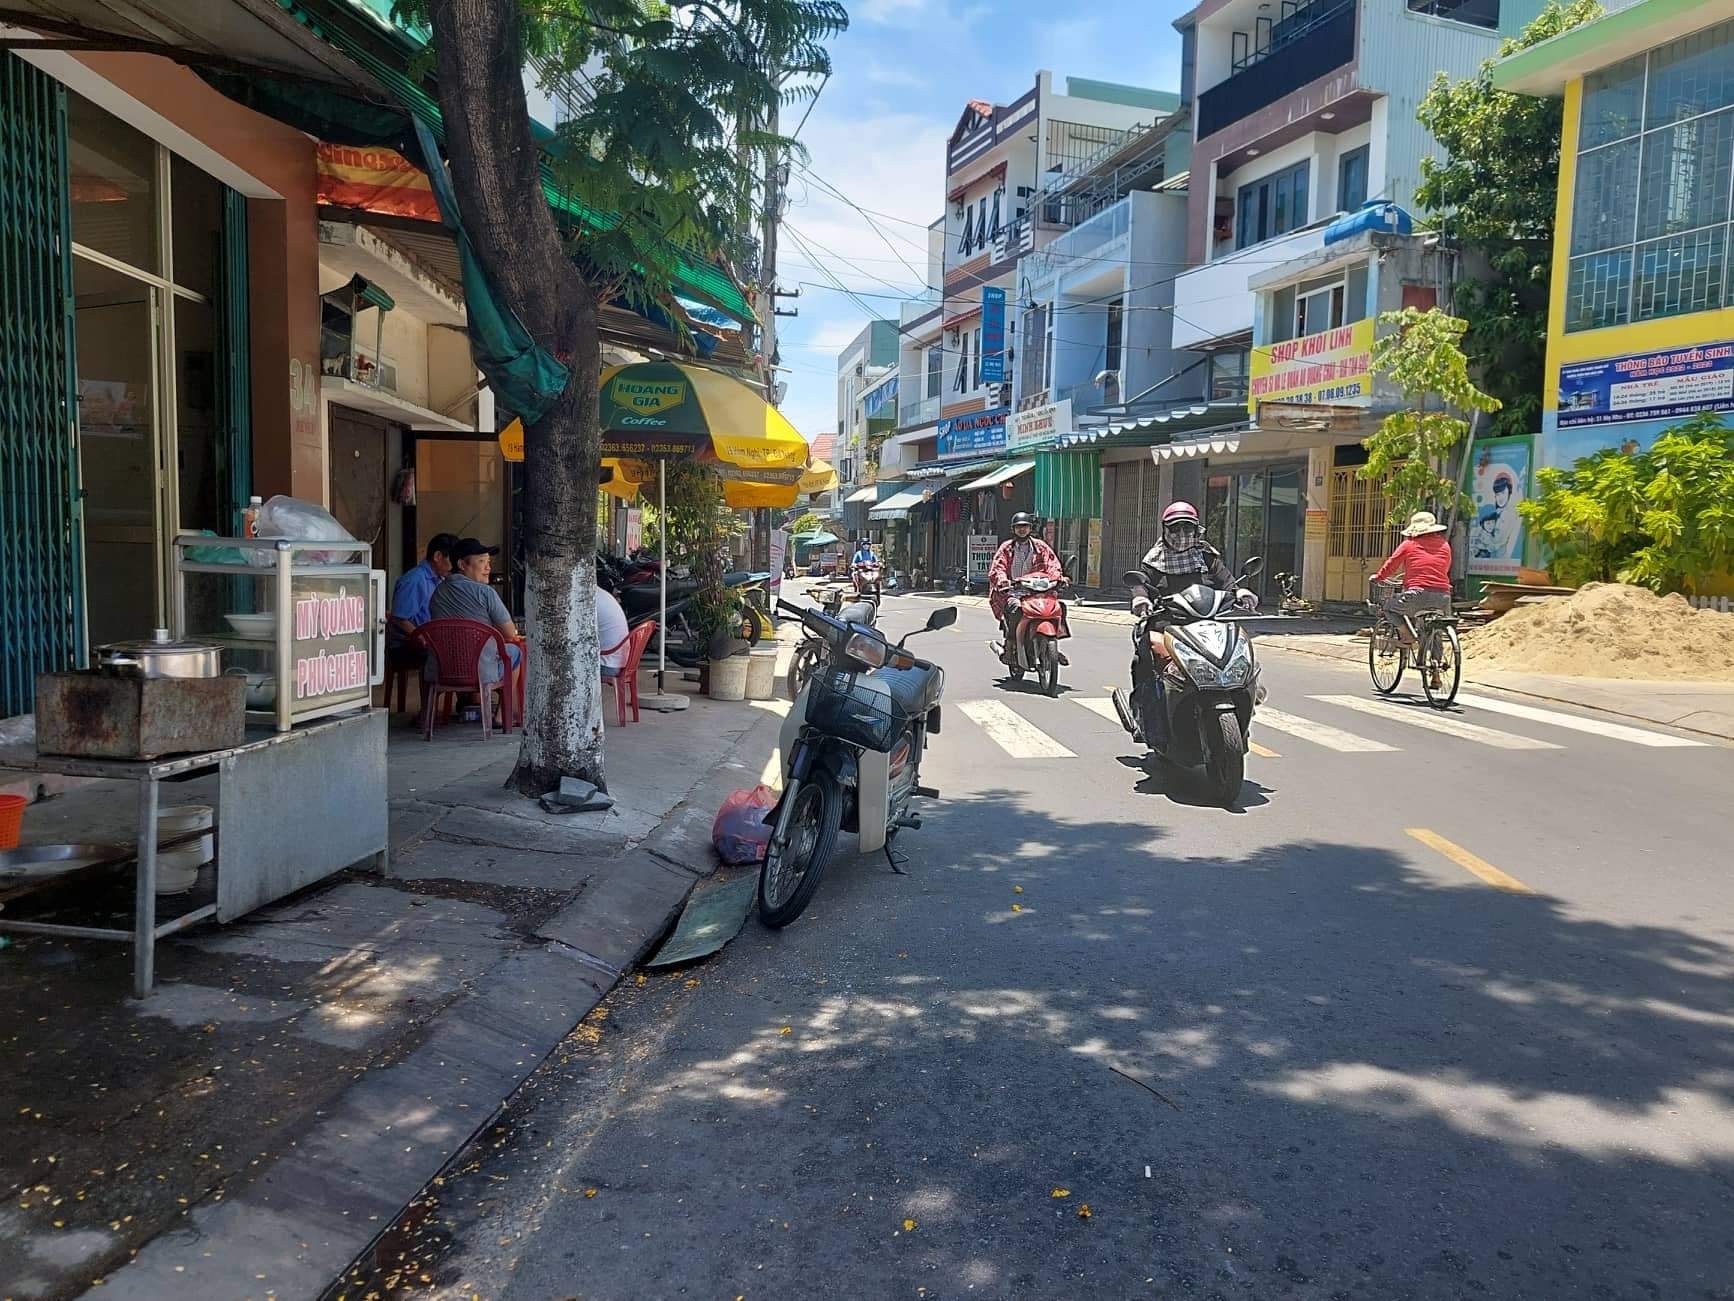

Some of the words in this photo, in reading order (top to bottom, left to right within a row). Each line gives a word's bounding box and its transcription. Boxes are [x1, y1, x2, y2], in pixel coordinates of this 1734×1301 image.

[1270, 342, 1298, 364] SHOP
[1329, 327, 1352, 351] LINH
[1615, 359, 1647, 372] THÔNG
[1648, 355, 1669, 368] BÁO
[1671, 348, 1703, 364] TUYỂN
[1704, 346, 1732, 359] SINH
[632, 396, 660, 407] GIA
[621, 416, 667, 426] Coffee
[320, 586, 365, 640] QUẢNG
[297, 649, 326, 699] PHÚ
[327, 645, 367, 692] CHIÊM
